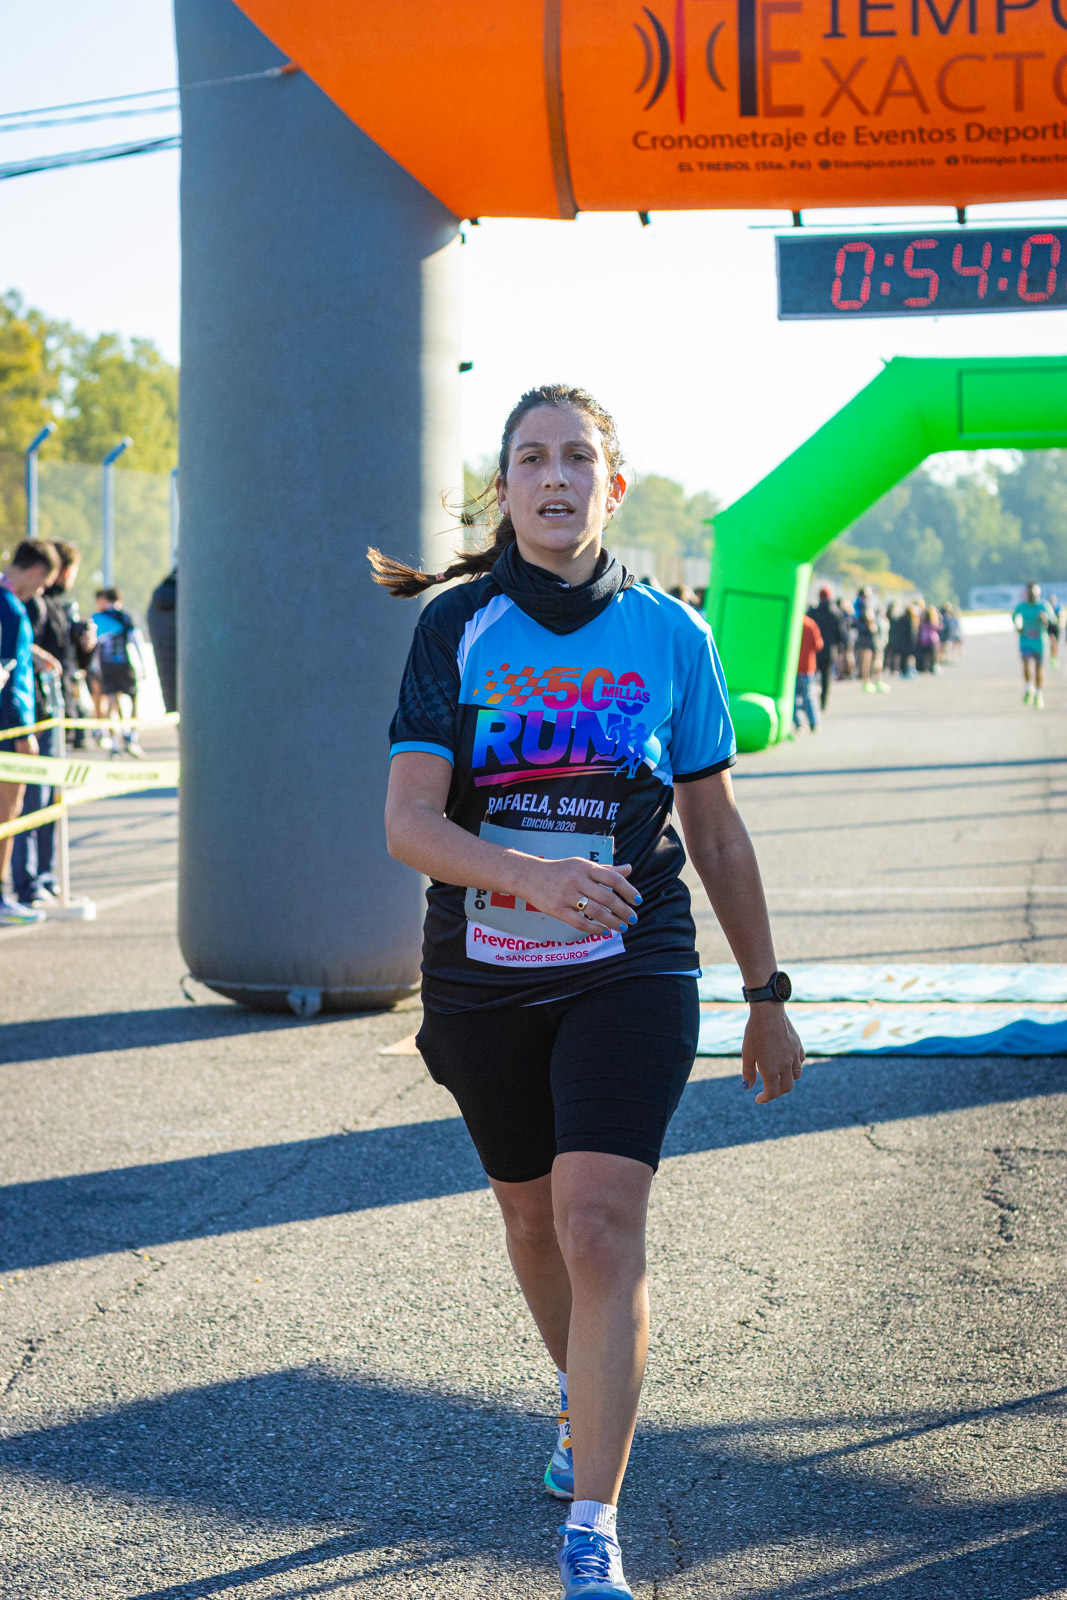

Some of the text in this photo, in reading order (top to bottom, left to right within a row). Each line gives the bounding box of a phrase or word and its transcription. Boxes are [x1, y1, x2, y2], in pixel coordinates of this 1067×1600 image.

[632, 128, 808, 151] Cronometraje
[814, 126, 847, 147] de
[854, 124, 957, 146] Eventos
[831, 233, 1067, 310] 0:54:0
[541, 666, 646, 716] 500
[601, 685, 650, 703] MILLAS
[471, 709, 623, 769] RUN
[488, 793, 553, 816] RAFAELA,
[557, 797, 605, 819] SANTA
[521, 816, 576, 832] EDICIÓN 2026
[495, 950, 589, 962] de SANCOR SEGUROS
